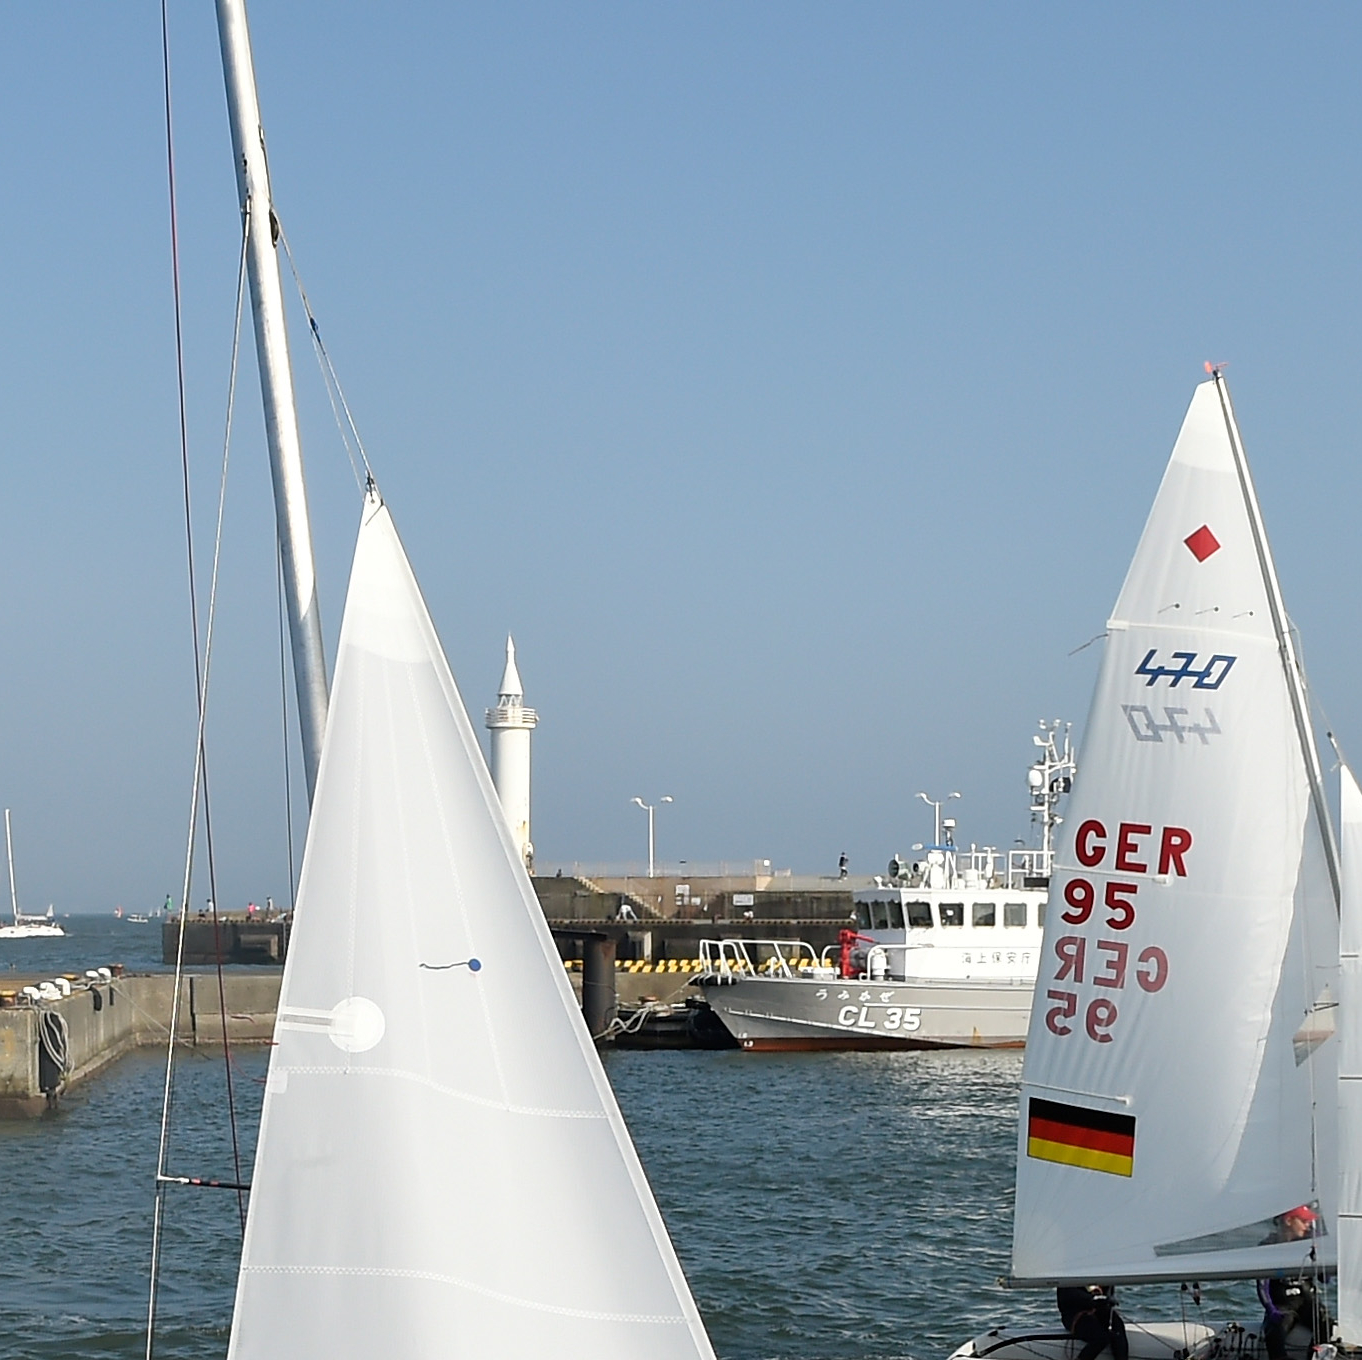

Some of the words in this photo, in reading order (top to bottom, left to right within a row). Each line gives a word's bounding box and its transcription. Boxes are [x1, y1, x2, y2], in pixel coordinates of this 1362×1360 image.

[1134, 649, 1237, 690] 470
[1075, 819, 1193, 877] GER
[1061, 878, 1138, 930] 95
[838, 1005, 876, 1029] CL
[883, 1007, 922, 1031] 35
